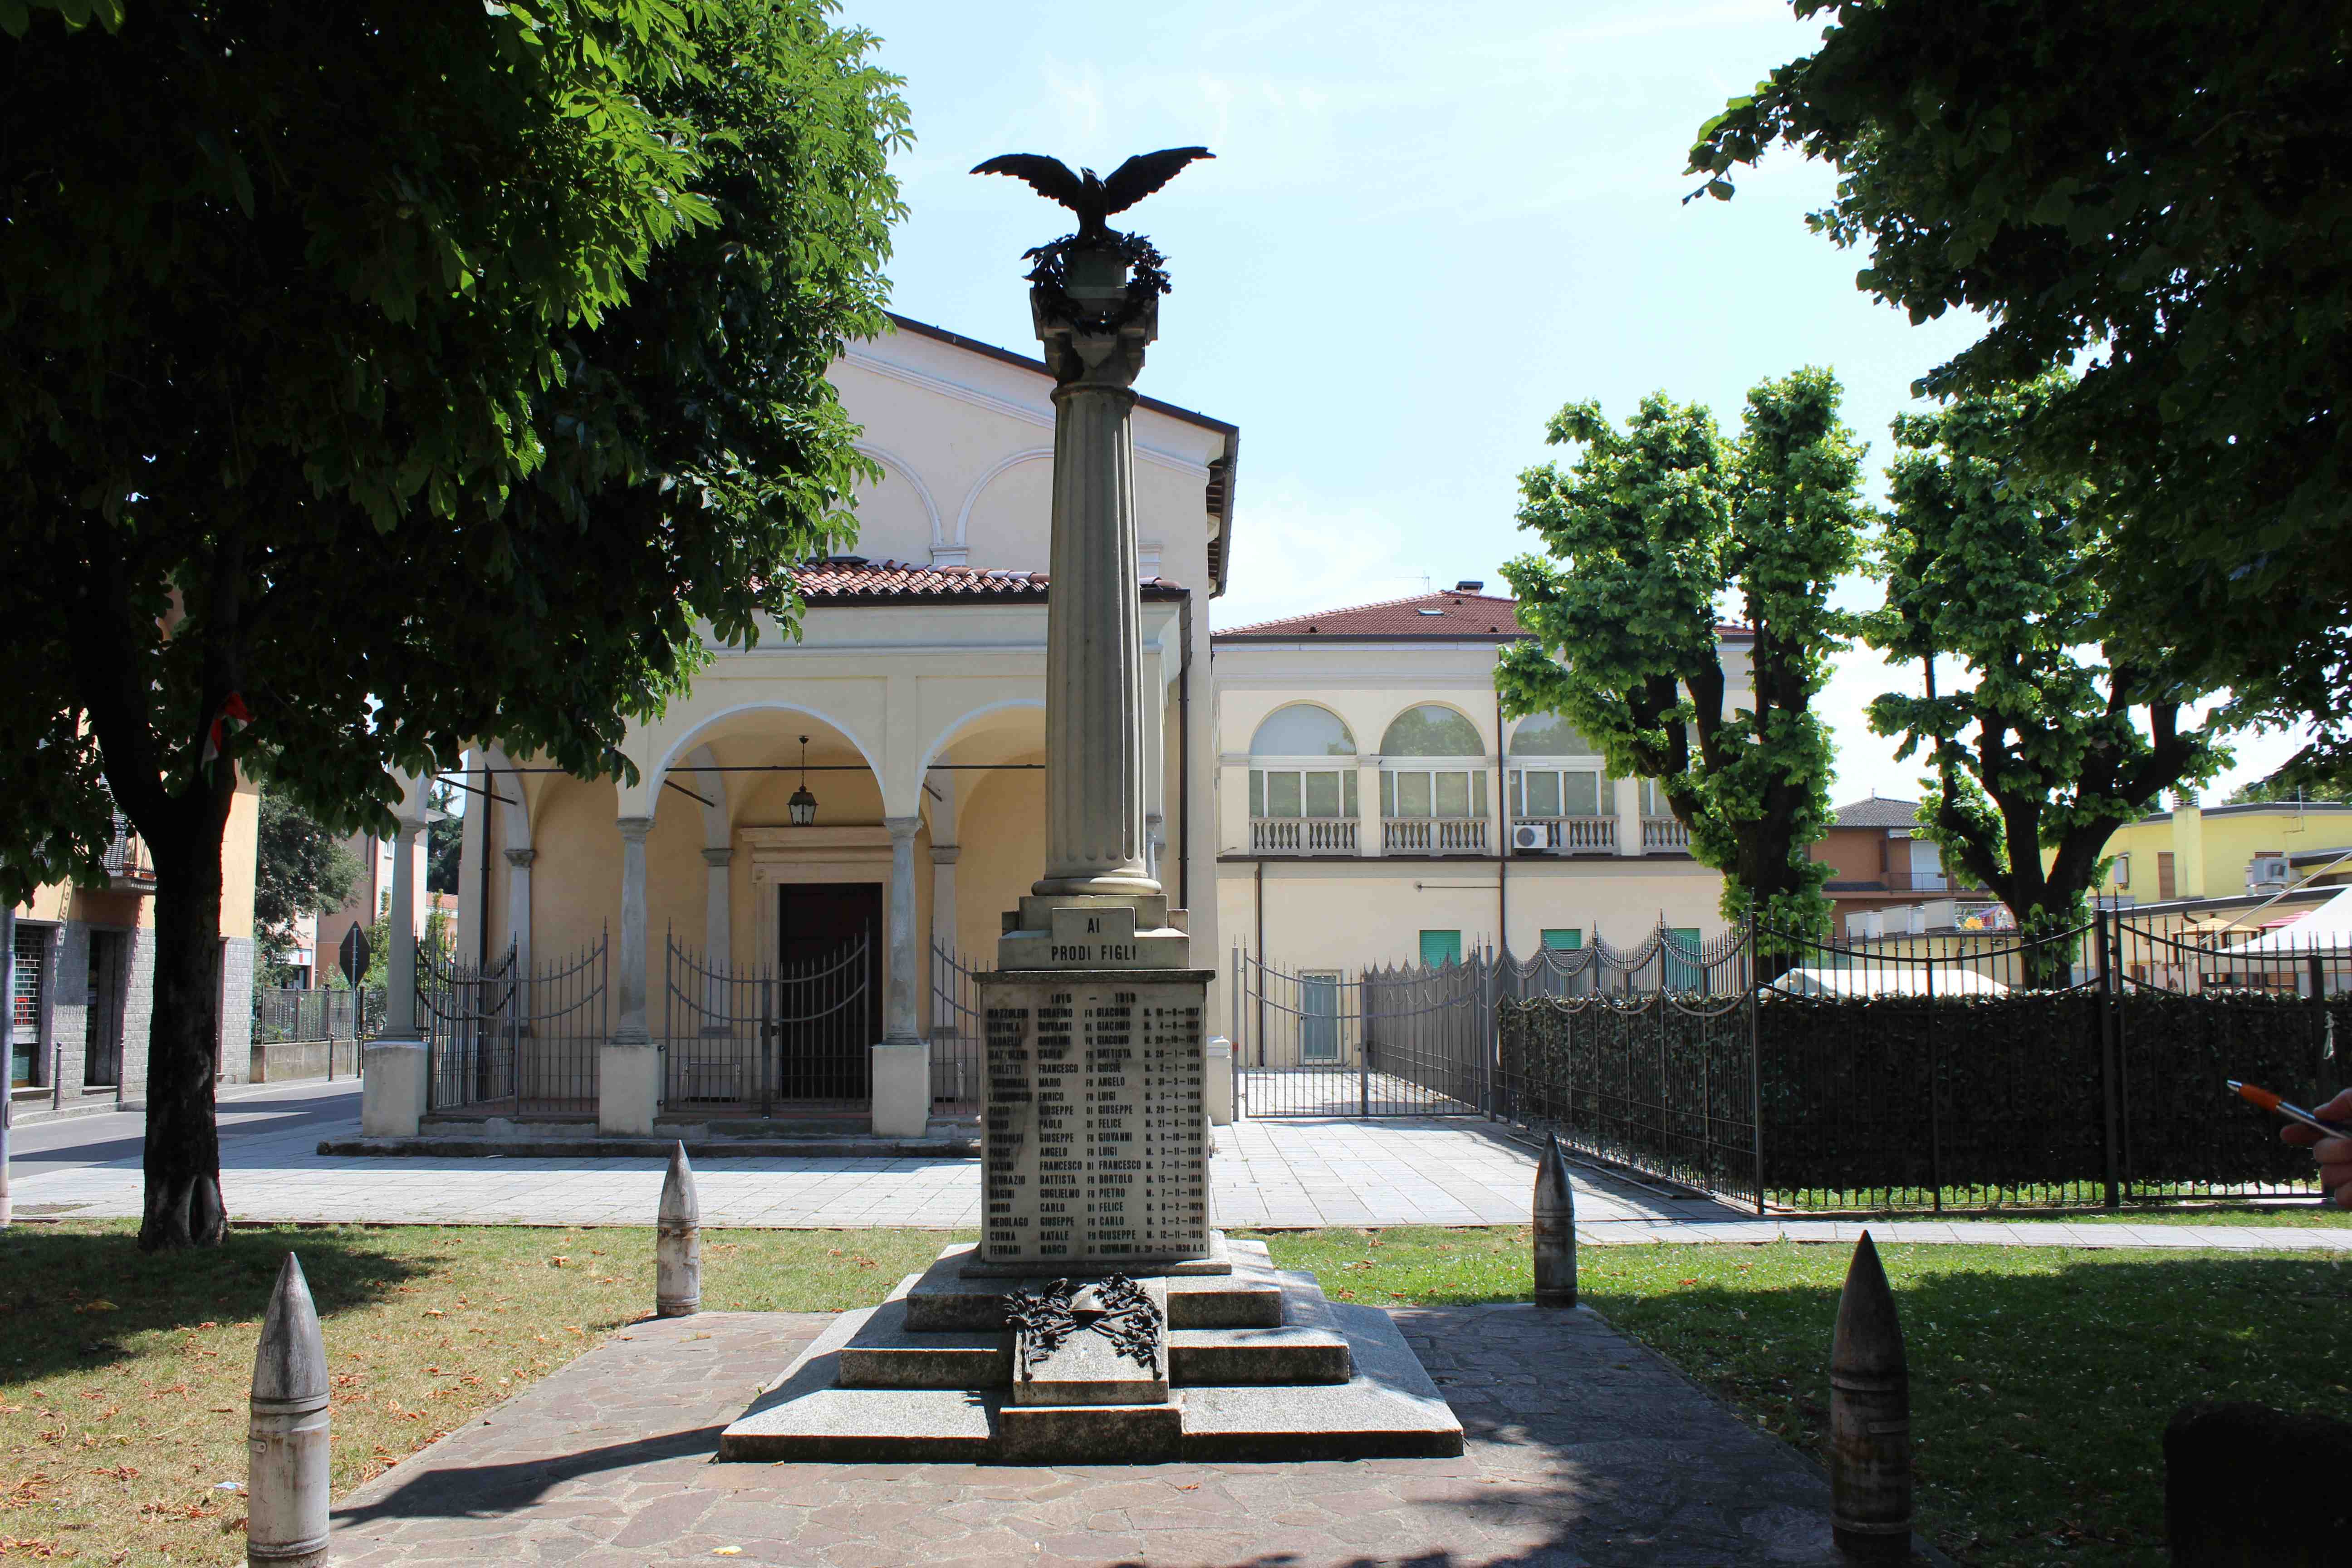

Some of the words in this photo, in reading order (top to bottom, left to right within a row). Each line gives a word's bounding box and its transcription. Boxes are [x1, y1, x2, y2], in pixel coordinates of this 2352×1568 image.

[1088, 918, 1100, 933] AI
[1052, 945, 1091, 961] PRODI
[1101, 945, 1136, 960] FIGLI
[1115, 993, 1136, 1003] 1918
[988, 1009, 1028, 1018] MAZZOLENI
[1038, 1009, 1072, 1018] SERAFINO
[1097, 1008, 1130, 1017] GIACOMO
[1144, 1008, 1151, 1017] M.
[1038, 1022, 1072, 1031] GIOVANNI
[1097, 1021, 1130, 1031] GIACOMO
[1144, 1022, 1152, 1030] M.
[1038, 1036, 1070, 1045] GIOVANNI
[1097, 1035, 1129, 1044] GIACOMO
[1144, 1036, 1152, 1044] M.
[1039, 1050, 1062, 1059] CARLO
[1086, 1051, 1093, 1059] FU
[1097, 1049, 1131, 1058] BATTISTA
[1144, 1050, 1152, 1058] M.
[1039, 1064, 1078, 1073] FRANCESCO
[1039, 1078, 1060, 1087] MARIO
[1098, 1077, 1125, 1087] ANGELO
[1145, 1078, 1153, 1086] M.
[1039, 1093, 1063, 1101] ENRICO
[1098, 1092, 1116, 1101] LUIGI
[1145, 1092, 1153, 1100] M.
[1039, 1106, 1073, 1115] GIUSEPPE
[1098, 1105, 1132, 1114] GIUSEPPE
[1145, 1106, 1153, 1114] M.
[1039, 1120, 1062, 1129] PAOLO
[1099, 1119, 1121, 1128] FELICE
[1145, 1120, 1153, 1128] M.
[1039, 1133, 1073, 1142] GIUSEPPE
[1098, 1132, 1132, 1142] GIOVANNI
[1146, 1133, 1153, 1142] M.
[1040, 1147, 1067, 1156] ANGELO
[1099, 1147, 1117, 1156] LUIGI
[1040, 1161, 1082, 1170] FRANCESCO
[1099, 1161, 1141, 1170] FRANCESCO
[1040, 1175, 1075, 1184] BATTISTA
[1099, 1174, 1132, 1184] BORTOLO
[1040, 1189, 1080, 1198] GUGLIELMO
[1099, 1188, 1125, 1198] PIETRO
[990, 1203, 1010, 1212] MORO
[1040, 1203, 1064, 1212] CARLO
[1099, 1202, 1123, 1212] FELICE
[990, 1217, 1028, 1227] MEDOLAGO
[1040, 1217, 1074, 1226] GIUSEPPE
[1100, 1216, 1124, 1226] CARLO
[990, 1231, 1015, 1241] CORNA
[1041, 1231, 1068, 1240] NATALE
[1099, 1230, 1136, 1240] GIUSEPPE
[990, 1245, 1021, 1255] FERRARI
[1041, 1245, 1067, 1254] MARCO
[1100, 1244, 1132, 1254] GIOVANNI
